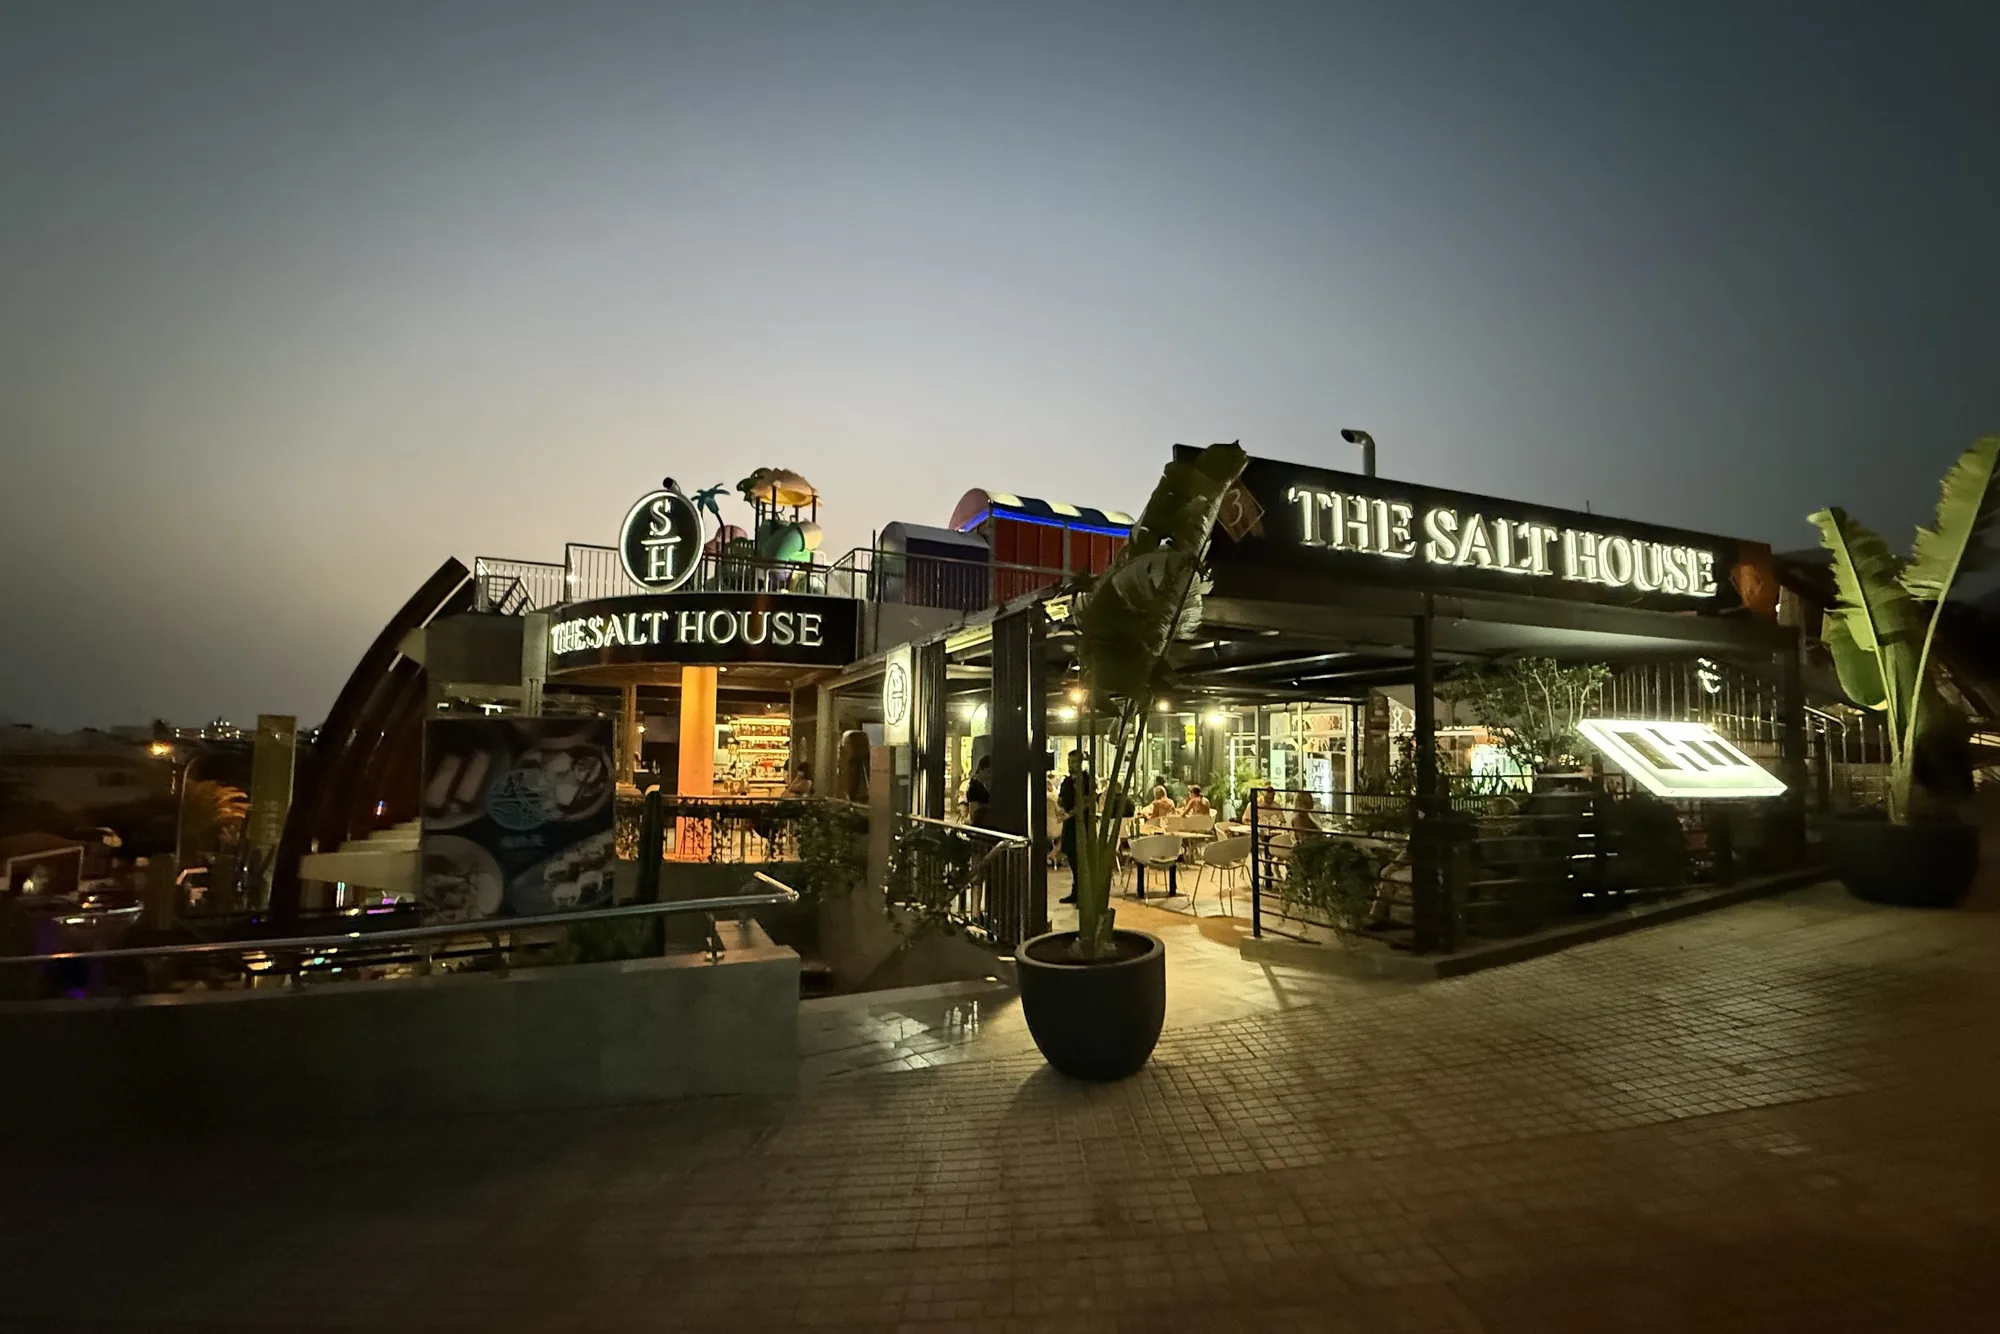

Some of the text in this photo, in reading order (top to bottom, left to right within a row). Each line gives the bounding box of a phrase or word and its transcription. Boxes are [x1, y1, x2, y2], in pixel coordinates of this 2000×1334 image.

[649, 499, 671, 536] S
[1288, 486, 1717, 596] THE SALT HOUSE
[644, 545, 676, 580] H
[551, 609, 824, 655] THE SALT HOUSE
